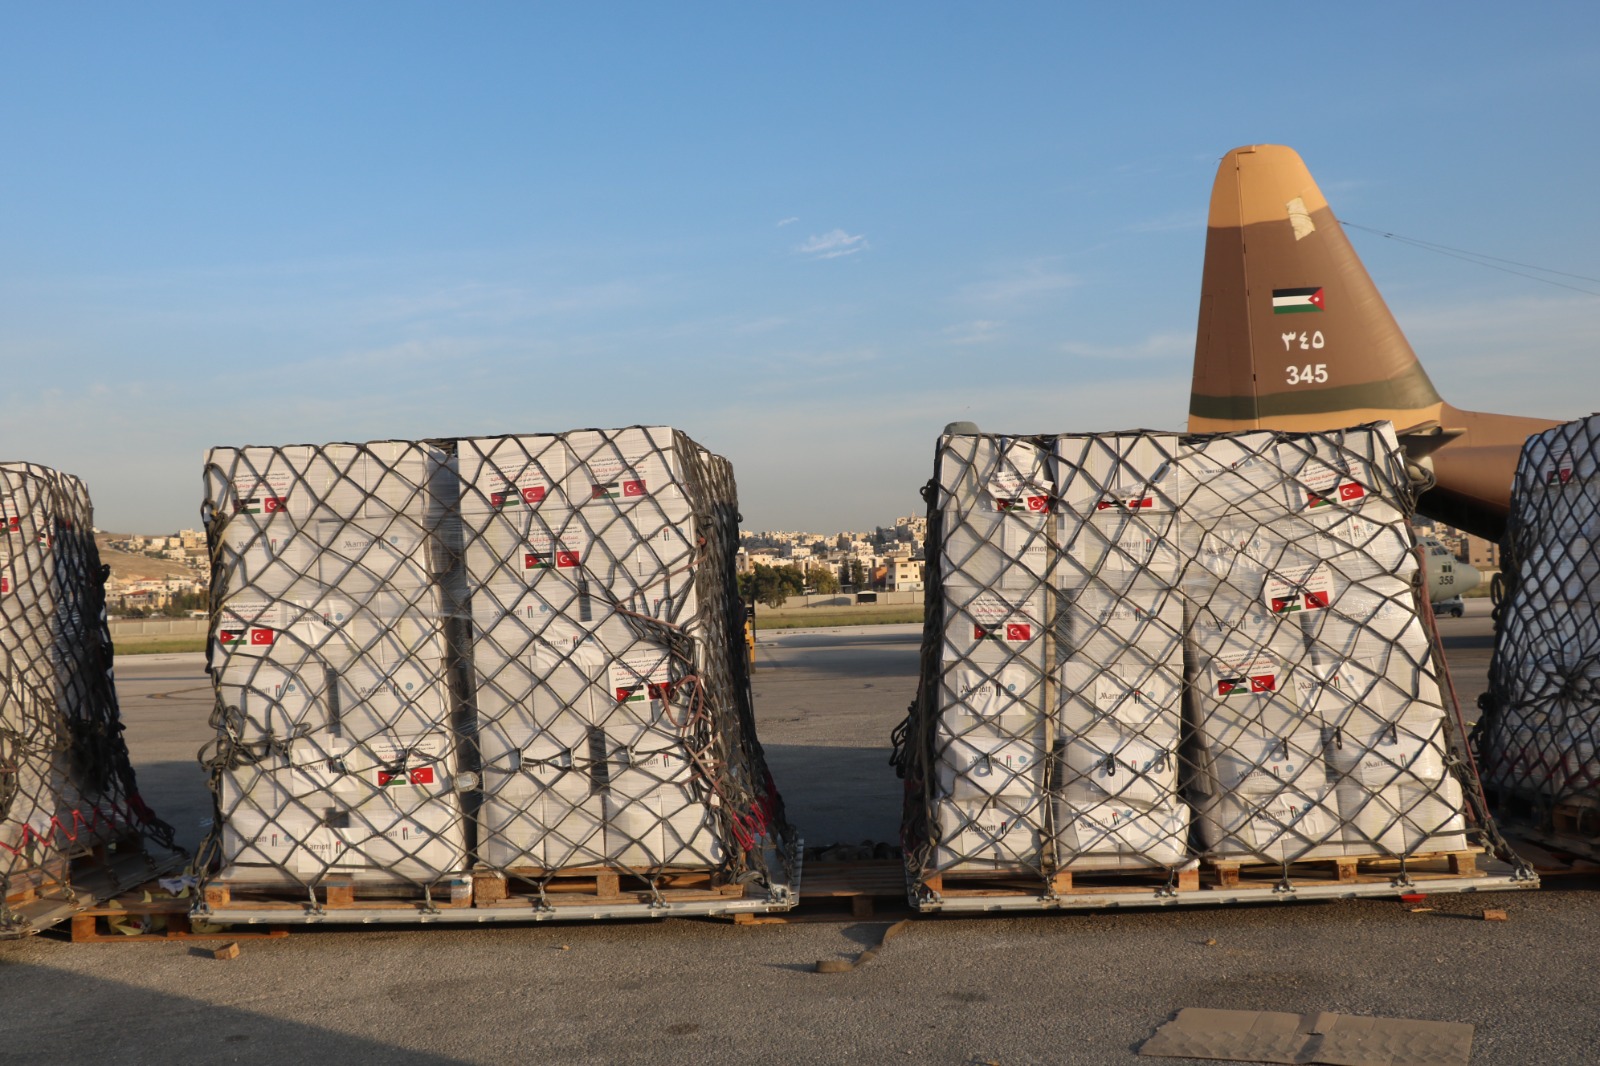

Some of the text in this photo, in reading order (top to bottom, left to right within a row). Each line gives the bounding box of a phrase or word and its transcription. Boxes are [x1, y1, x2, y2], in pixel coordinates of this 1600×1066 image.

[1281, 330, 1325, 352] ٣٤٥
[1285, 363, 1329, 385] 345
[1439, 575, 1454, 585] 358
